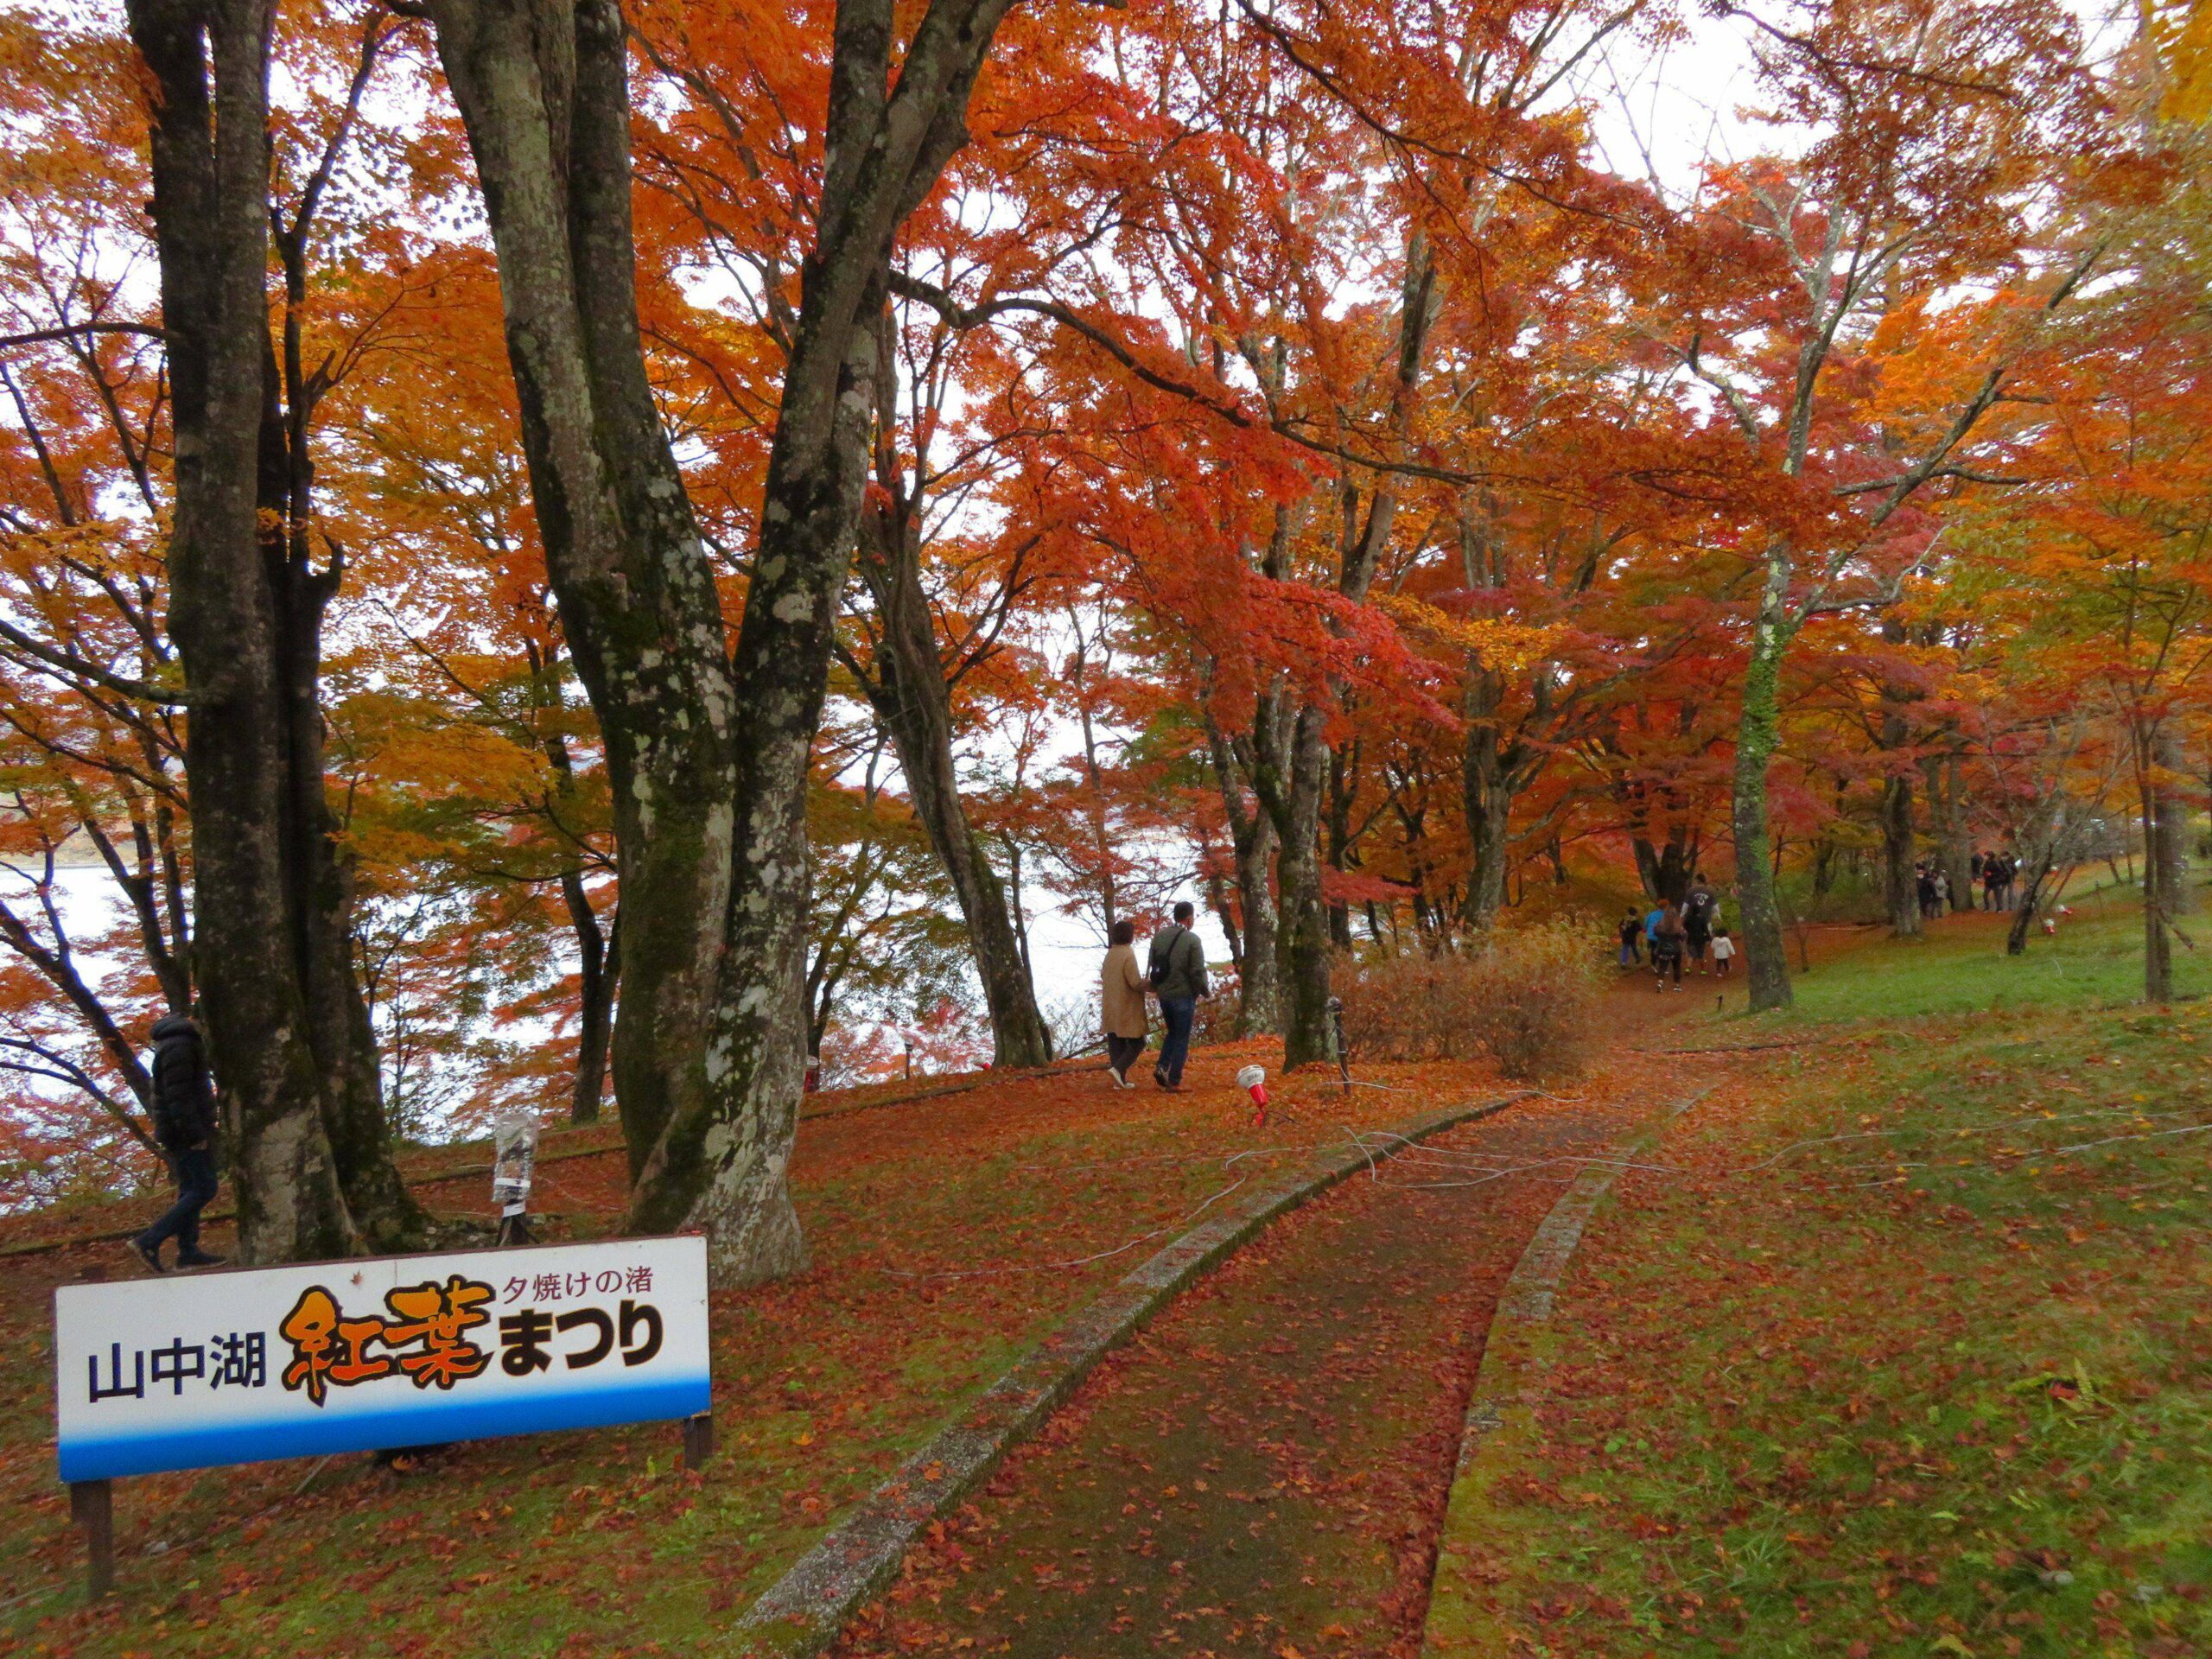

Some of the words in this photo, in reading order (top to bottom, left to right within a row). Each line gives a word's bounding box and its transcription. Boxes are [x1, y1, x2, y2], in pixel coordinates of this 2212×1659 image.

[503, 1265, 654, 1305] 夕焼けの渚
[87, 1332, 266, 1402] 山中湖
